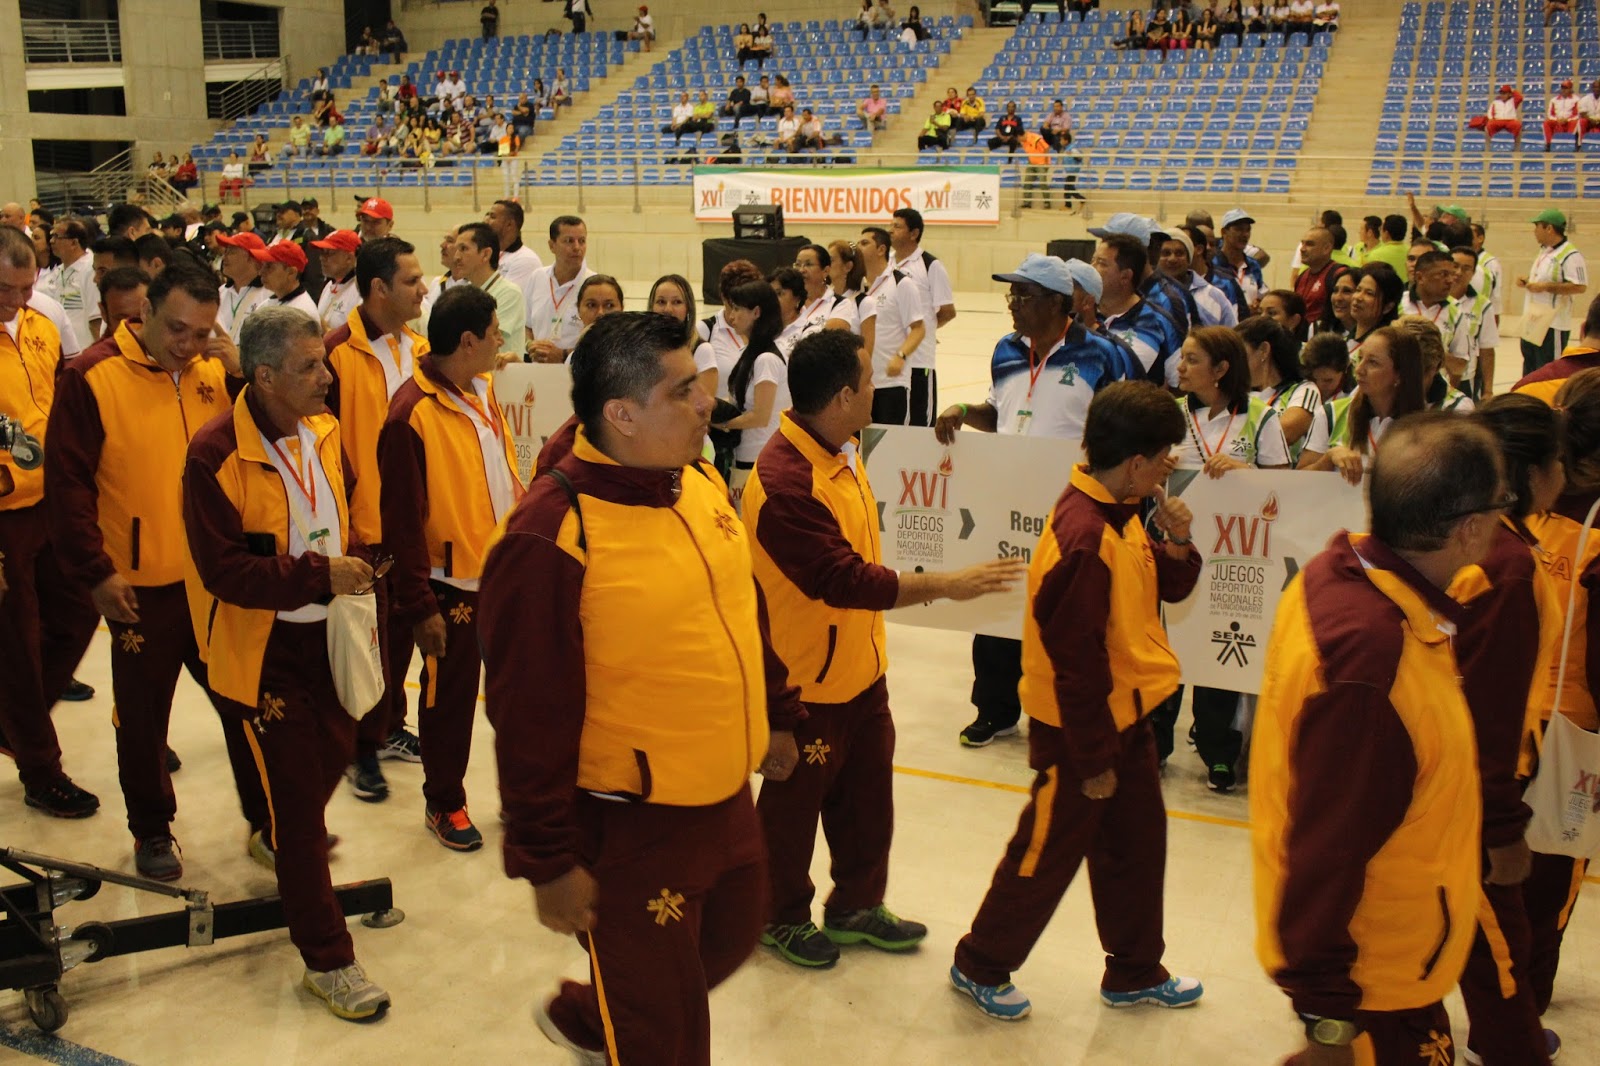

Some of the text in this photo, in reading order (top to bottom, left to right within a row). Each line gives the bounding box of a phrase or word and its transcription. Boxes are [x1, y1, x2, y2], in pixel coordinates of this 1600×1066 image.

[701, 189, 723, 208] XVI
[770, 187, 912, 214] BIENVENIDOS
[925, 190, 949, 209] XVI
[515, 444, 531, 459] GOS
[900, 470, 948, 510] XVI
[897, 514, 944, 533] JUEGOS
[896, 530, 944, 543] DEPORTIVOS
[1213, 515, 1270, 558] XVI
[896, 540, 944, 553] NACIONALES
[1211, 564, 1265, 585] JUEGOS
[1210, 581, 1264, 596] DEPORTIVOS
[1209, 592, 1264, 607] NACIONALES
[1212, 630, 1256, 643] SENA
